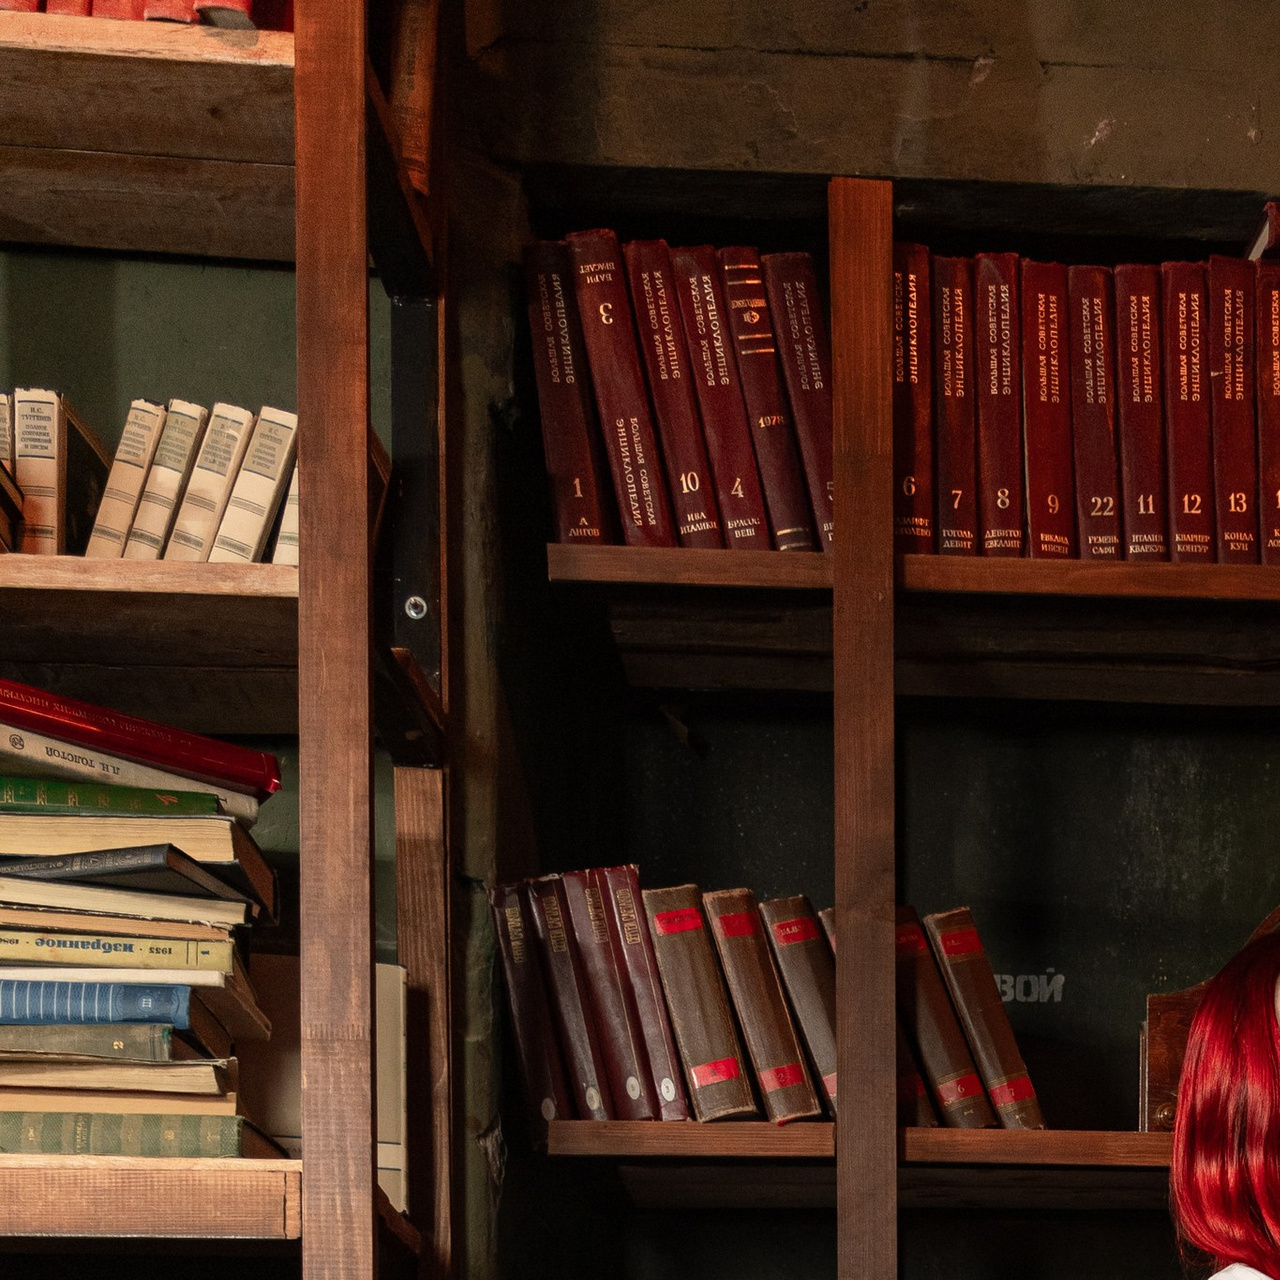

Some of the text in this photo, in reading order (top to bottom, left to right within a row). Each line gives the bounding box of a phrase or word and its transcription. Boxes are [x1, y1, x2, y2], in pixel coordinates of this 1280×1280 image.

[538, 274, 553, 331] СОВЕТСКАЯ
[551, 274, 575, 384] ЭНЦИКЛОПЕДИЯ
[599, 302, 614, 325] 3
[641, 272, 668, 380] БОЛЬШАЯ СОВЕТСКАЯ
[654, 271, 681, 379] ЭНЦИКЛОПЕДИЯ
[689, 277, 715, 387] БОЛЬШАЯ СОВЕТСКАЯ
[702, 274, 730, 386] ЭНЦИКЛОПЕДИЯ
[942, 287, 953, 396] БОЛЬШАЯ СОВЕТСКАЯ
[955, 288, 964, 398] ЭНЦИКЛОПЕДИЯ
[988, 285, 999, 395] БОЛЬШАЯ СОВЕТСКАЯ
[1000, 284, 1011, 396] ЭНЦИКЛОПЕДИЯ
[1037, 293, 1048, 402] БОЛЬШАЯ СОВЕТСКАЯ
[1050, 295, 1060, 403] ЭНЦИКЛОПЕДИЯ
[1082, 297, 1094, 404] БОЛЬШАЯ СОВЕТСКАЯ
[1093, 298, 1106, 404] ЭНЦИКЛОПЕДИЯ
[1129, 295, 1140, 403] БОЛЬШАЯ СОВЕТСКАЯ
[1144, 295, 1153, 403] ЭНЦИКЛОПЕДИЯ
[1178, 292, 1188, 401] БОЛЬШАЯ СОВЕТСКАЯ
[1191, 293, 1201, 401] ЭНЦИКЛОПЕДИЯ
[1224, 289, 1233, 400] БОЛЬШАЯ СОВЕТСКАЯ
[1234, 289, 1244, 401] ЭНЦИКЛОПЕДИЯ
[1273, 349, 1280, 396] БОЛЬШАЯ
[573, 478, 583, 497] 1
[616, 418, 642, 527] ЭНЦИКЛОПЕДИЯ
[639, 469, 657, 526] СОВЕТСКАЯ
[680, 472, 699, 493] 10
[731, 478, 743, 498] 4
[902, 476, 916, 496] 6
[951, 490, 963, 510] 7
[996, 488, 1010, 509] 8
[1047, 495, 1059, 515] 9
[1091, 496, 1114, 517] 22
[1137, 495, 1155, 515] 11
[1182, 494, 1202, 514] 12
[1229, 493, 1247, 512] 13
[45, 747, 95, 768] ТОЛСТОЙ
[34, 937, 134, 953] избранное
[112, 1040, 124, 1050] 2
[957, 1084, 965, 1093] 6
